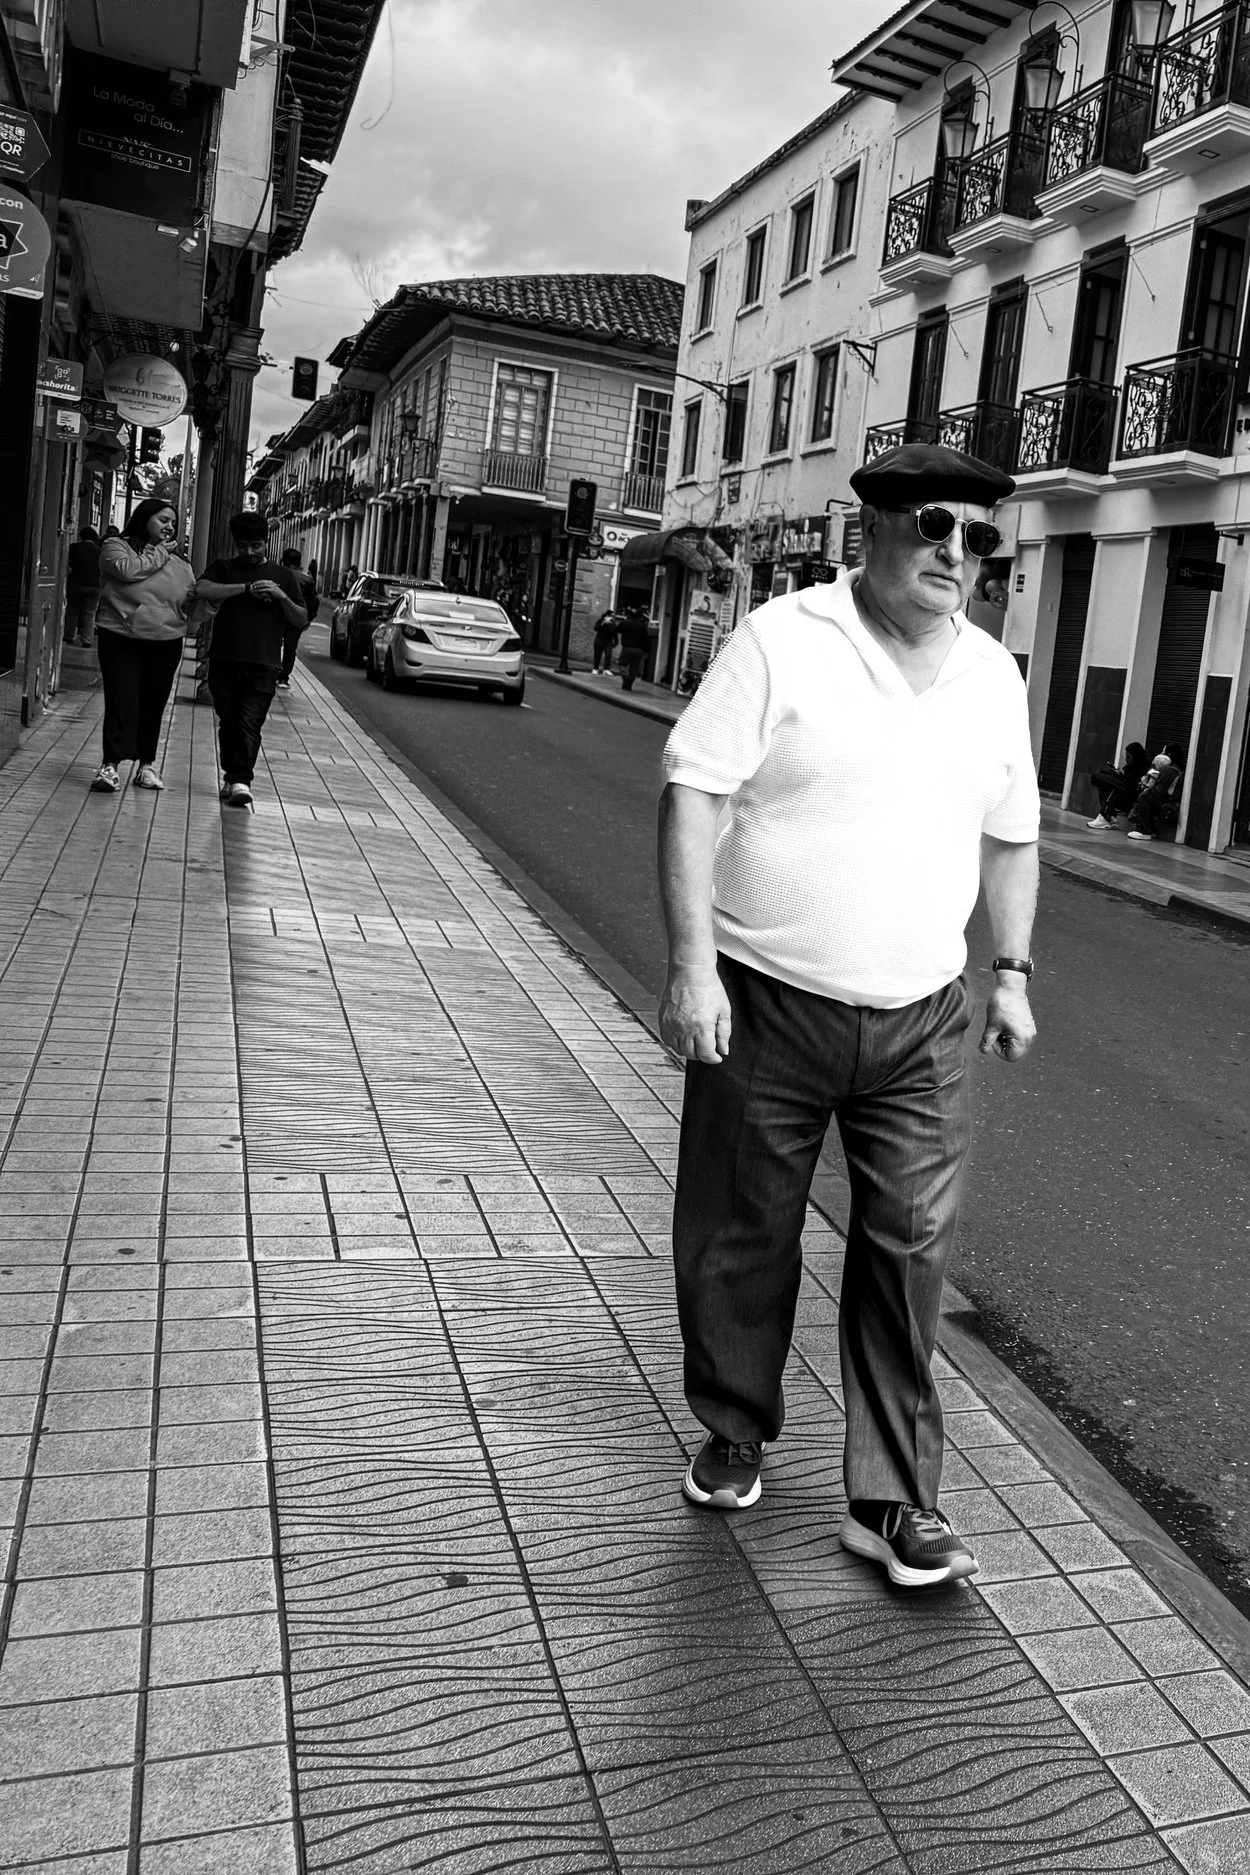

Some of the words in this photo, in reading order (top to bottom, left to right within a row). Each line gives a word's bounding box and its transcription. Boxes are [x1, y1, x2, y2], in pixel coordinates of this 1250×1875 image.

[93, 85, 110, 100] La
[113, 91, 155, 112] Moda
[133, 112, 147, 123] al
[1, 141, 22, 156] QR
[87, 135, 183, 166] NIEVECITAS
[151, 391, 181, 404] TORRES
